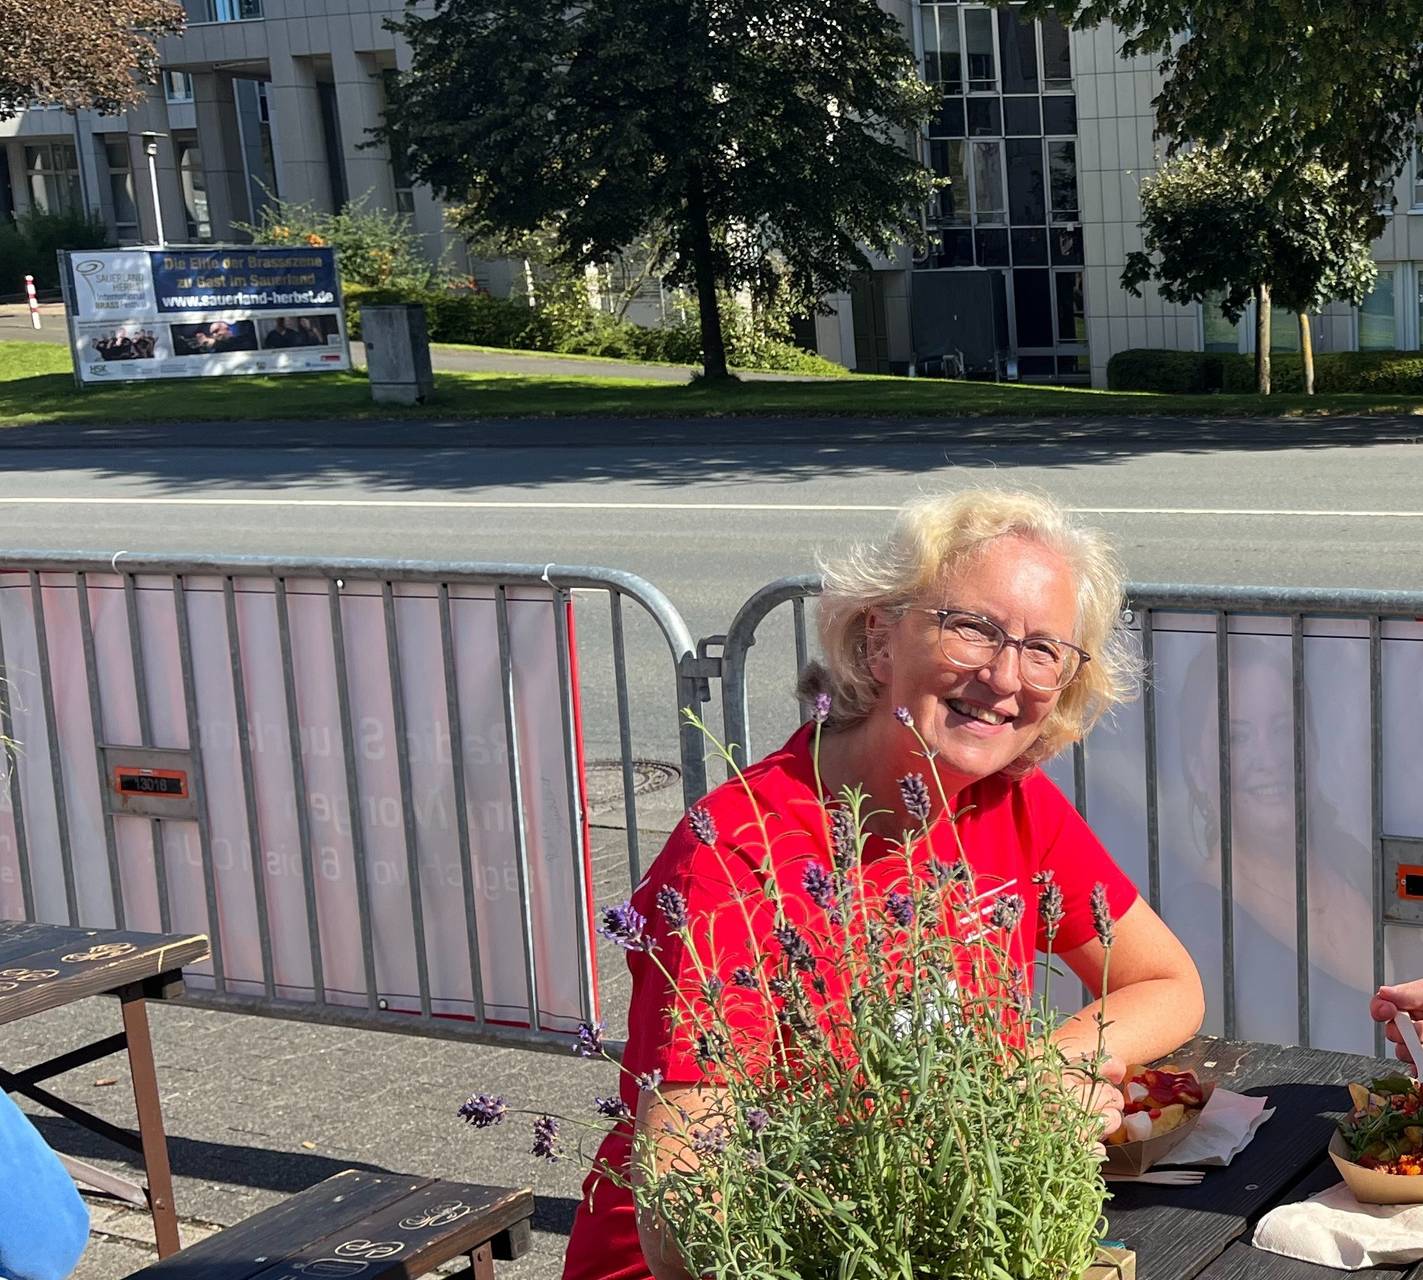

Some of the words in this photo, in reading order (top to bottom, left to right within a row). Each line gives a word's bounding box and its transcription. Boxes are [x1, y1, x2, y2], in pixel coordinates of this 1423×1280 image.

[164, 257, 186, 271] Die
[190, 256, 219, 270] Elite
[222, 256, 245, 269] der
[95, 272, 145, 283] SAUERLAND
[176, 277, 193, 289] zu
[196, 275, 226, 288] Gast
[230, 274, 247, 287] im
[249, 273, 316, 286] Sauerland
[161, 290, 335, 308] www.sauerland-herbst.de
